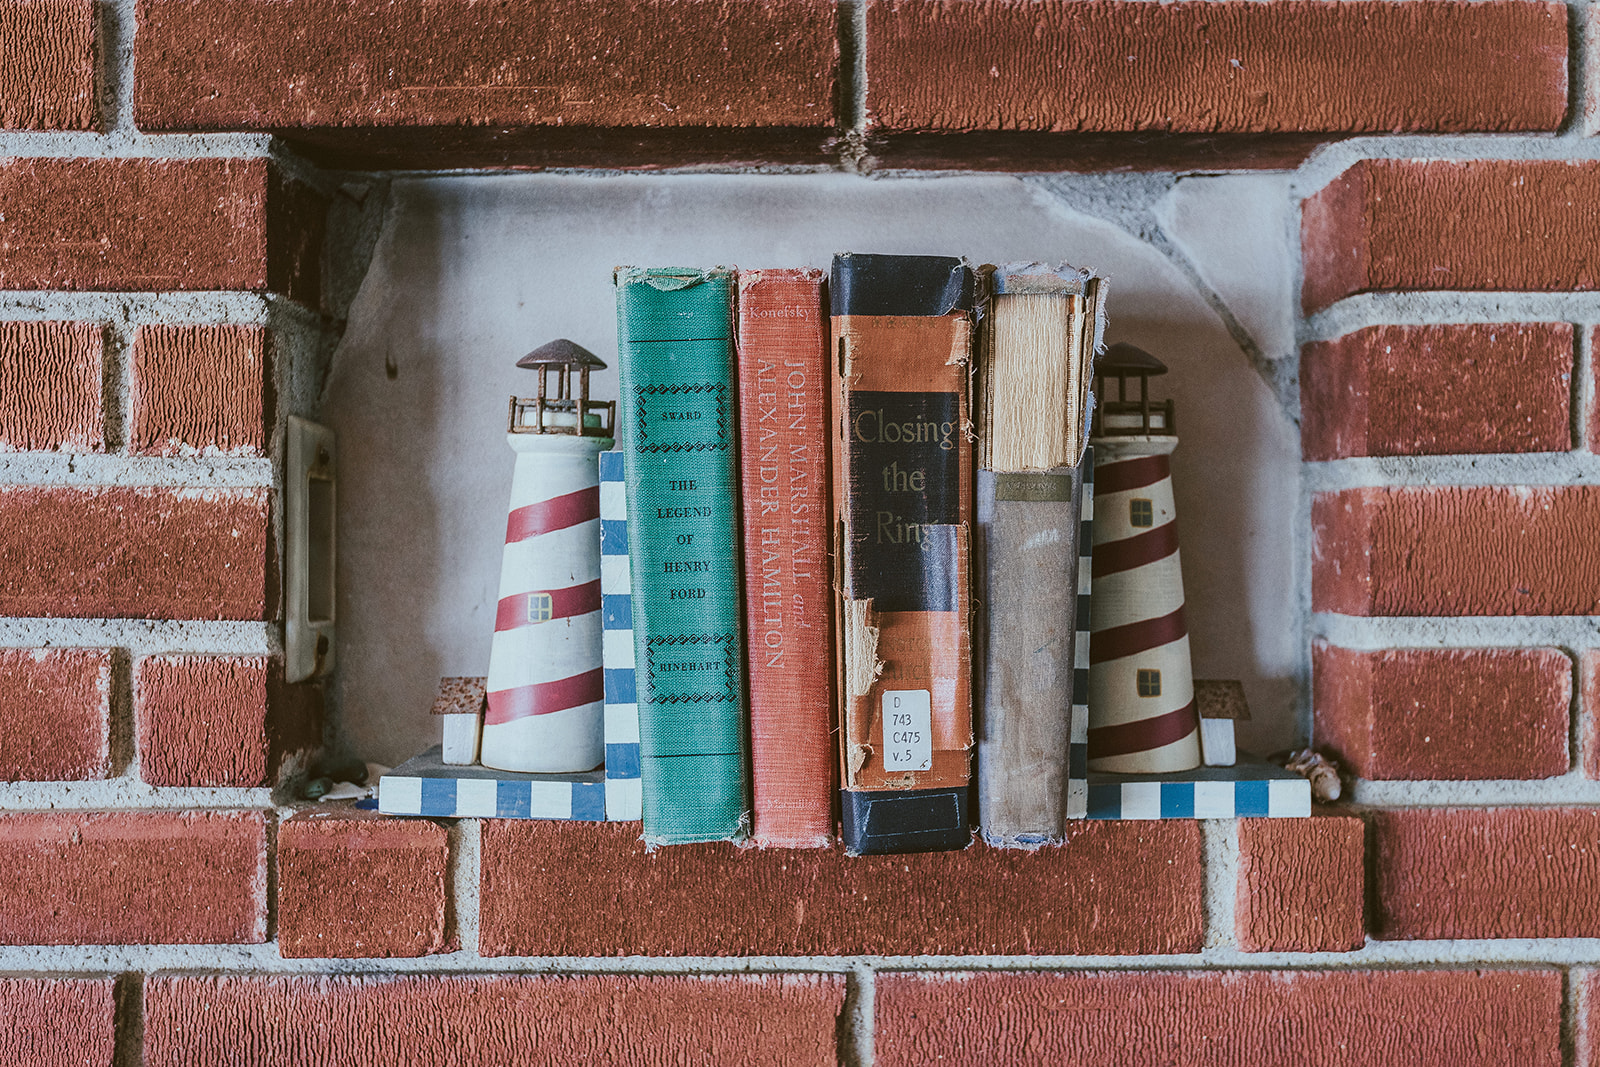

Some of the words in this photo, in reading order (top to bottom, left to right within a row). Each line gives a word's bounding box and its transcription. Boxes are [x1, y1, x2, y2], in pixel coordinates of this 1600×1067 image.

[750, 305, 811, 320] Konefsky
[785, 359, 806, 430] JOHN
[662, 411, 702, 421] SWARD
[855, 408, 958, 450] Closing
[757, 359, 780, 517] ALEXANDER
[882, 460, 926, 492] the
[669, 479, 698, 491] THE
[657, 506, 712, 519] LEGEND
[789, 443, 811, 585] MARSHALL
[876, 511, 939, 552] Ring
[676, 534, 695, 545] OF
[663, 561, 711, 573] HENRY
[670, 588, 706, 600] FORD
[761, 527, 785, 669] HAMILTON
[792, 593, 811, 628] and
[659, 661, 721, 673] RINEHART
[893, 696, 901, 709] D
[893, 713, 912, 726] 743
[893, 731, 921, 744] C475
[892, 749, 912, 762] v.5
